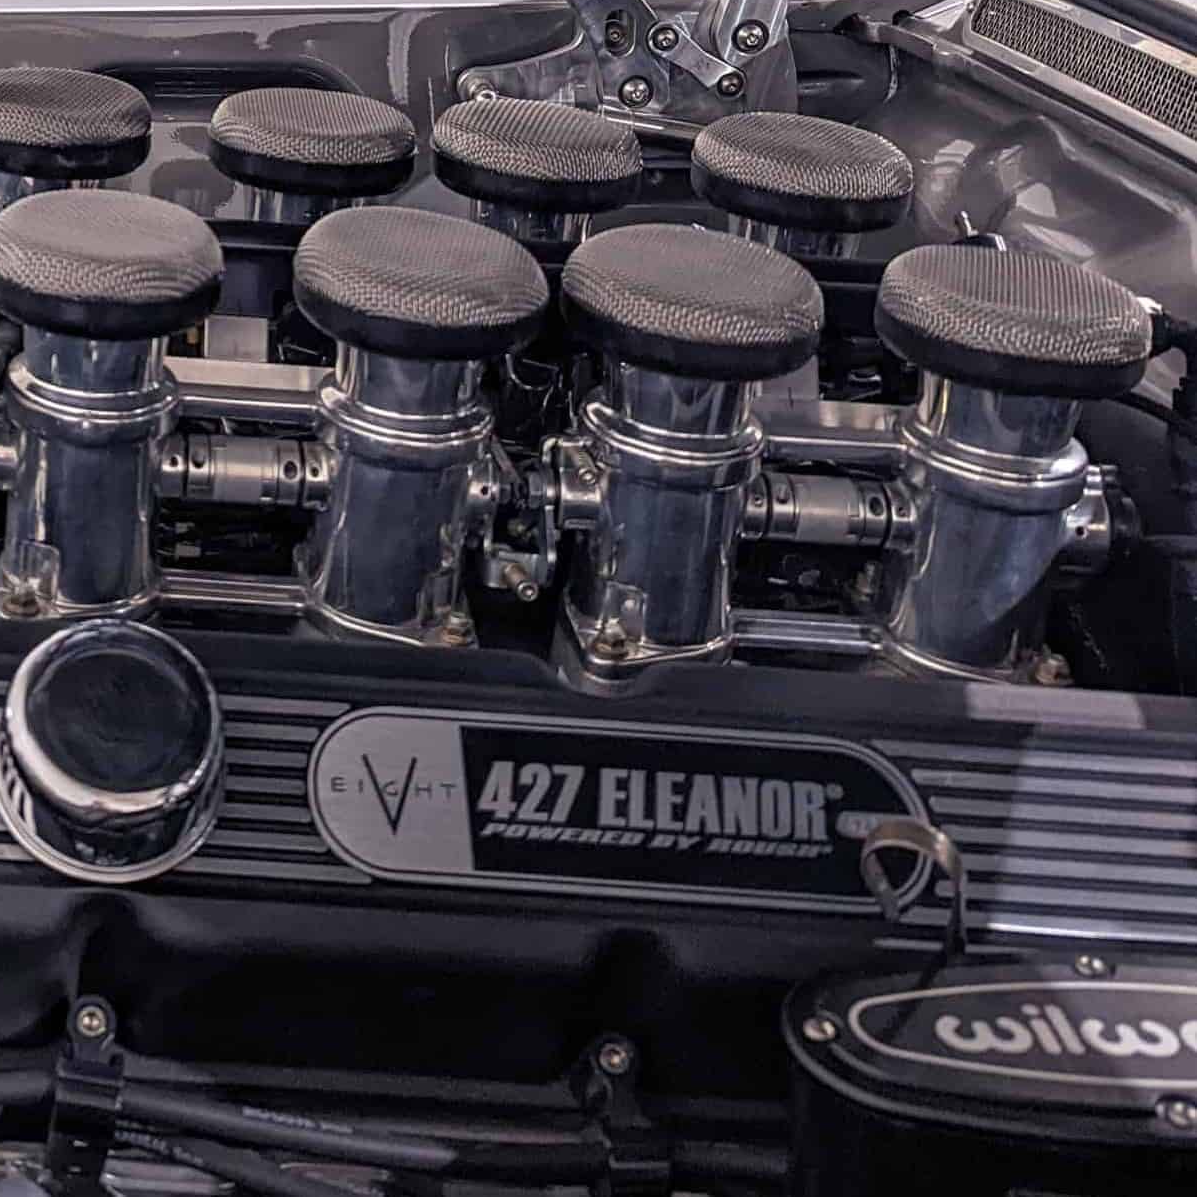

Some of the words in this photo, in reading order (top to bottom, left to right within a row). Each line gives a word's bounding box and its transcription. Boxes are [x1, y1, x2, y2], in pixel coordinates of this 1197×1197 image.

[331, 776, 457, 799] EIGHT
[477, 760, 586, 823] 427
[480, 822, 646, 847] POWERED
[648, 833, 701, 851] BY
